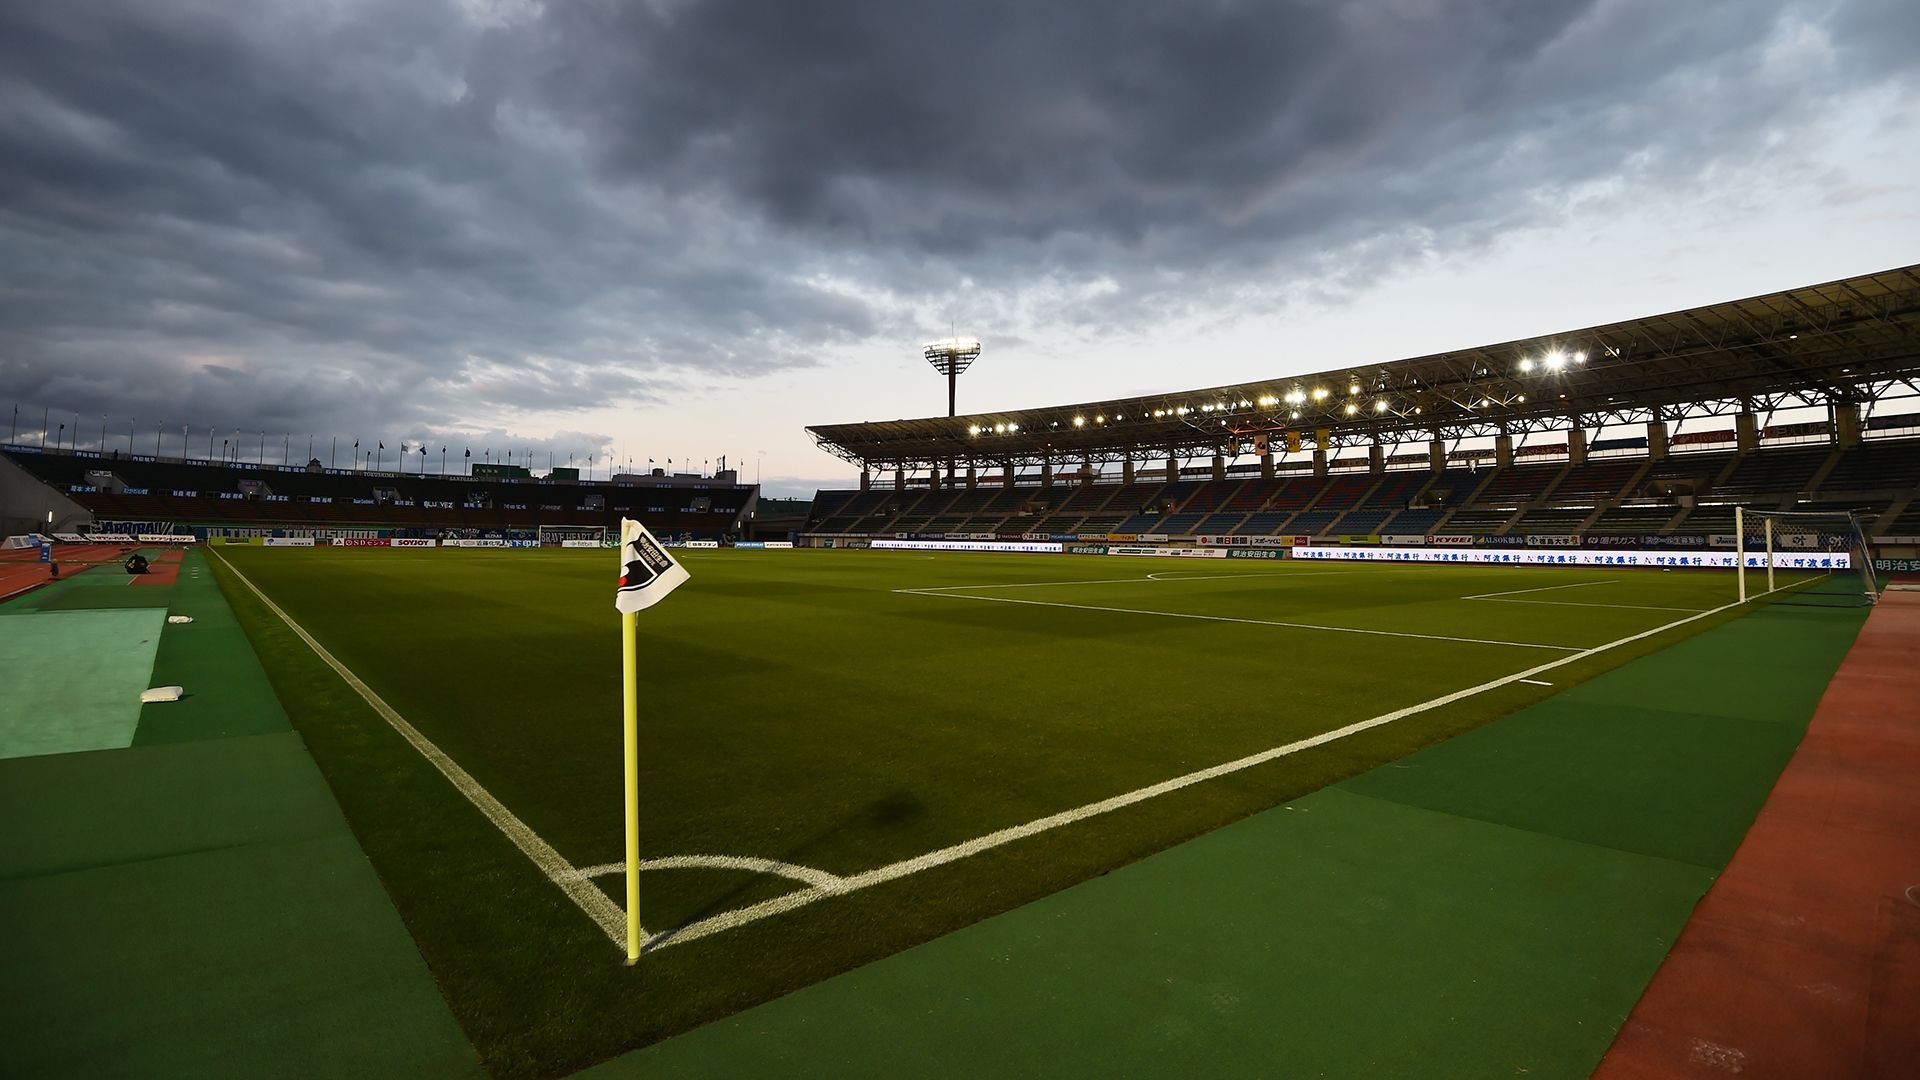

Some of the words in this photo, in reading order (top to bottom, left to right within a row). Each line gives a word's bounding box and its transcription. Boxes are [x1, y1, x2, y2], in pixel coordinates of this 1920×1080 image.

[282, 530, 378, 539] TOKUSHIMA
[541, 532, 564, 543] BRAVE
[1485, 536, 1524, 544] ALSOK徳島
[1600, 536, 1636, 545] 鳴門ガス
[1232, 550, 1276, 558] 明治安田生命
[1344, 552, 1374, 560] 阿波銀行
[1387, 553, 1419, 561] 阿波銀行
[1434, 553, 1468, 562] 阿波銀行
[1484, 554, 1520, 563] 阿波銀行
[1537, 555, 1577, 564] 阿波銀行
[1594, 556, 1638, 565] 阿波銀行
[1656, 557, 1702, 566] 阿波銀行
[1794, 558, 1847, 568] 阿波銀行
